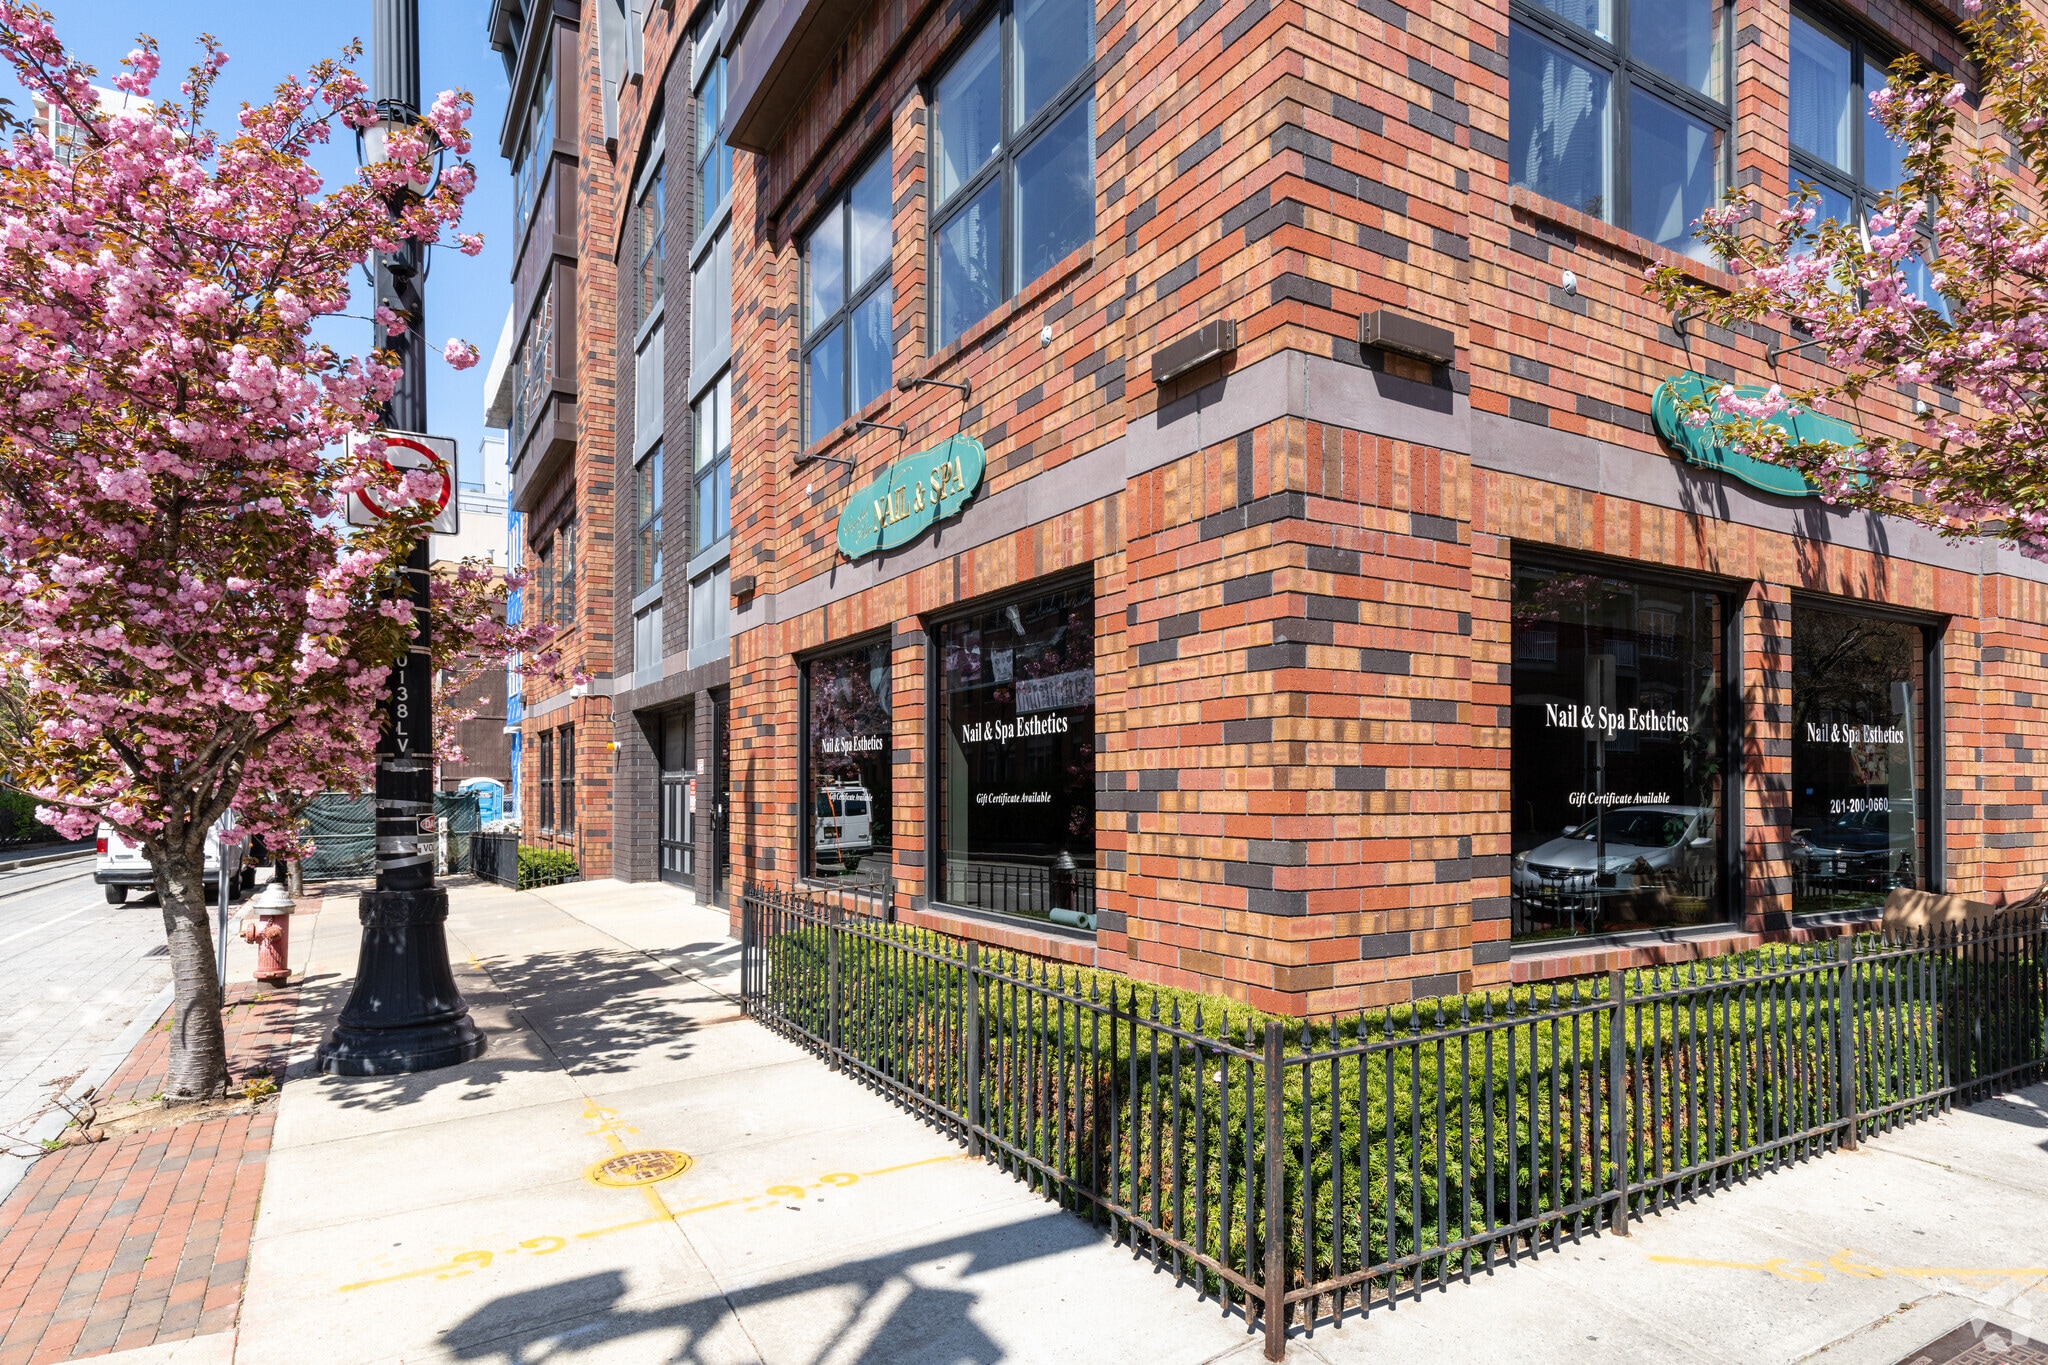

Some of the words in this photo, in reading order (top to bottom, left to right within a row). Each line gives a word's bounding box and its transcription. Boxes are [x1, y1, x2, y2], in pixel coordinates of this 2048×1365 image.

[873, 485, 910, 533] NAIL
[913, 480, 926, 513] &
[930, 455, 965, 506] SPA
[962, 722, 982, 743] Nail
[983, 721, 993, 741] &
[995, 719, 1014, 745] Spa
[1016, 712, 1068, 737] Esthetics
[1545, 703, 1578, 727] Nail
[1581, 705, 1595, 729] &
[1598, 706, 1625, 736] Spa
[1628, 708, 1689, 732] Esthetics
[821, 738, 834, 753] Nail
[834, 737, 840, 752] &
[841, 736, 853, 756] Spa
[853, 734, 883, 752] Esthetics
[1807, 722, 1829, 742] Nail
[1831, 723, 1840, 742] &
[1842, 723, 1860, 748] Spa
[1863, 724, 1904, 744] Esthetics
[976, 793, 988, 806] Gift
[988, 792, 1020, 806] Certificate
[1020, 791, 1051, 803] Available
[1569, 792, 1587, 807] Gift
[1588, 792, 1633, 807] Certificate
[1632, 792, 1670, 804] Available
[1830, 797, 1889, 813] 201-200-0660
